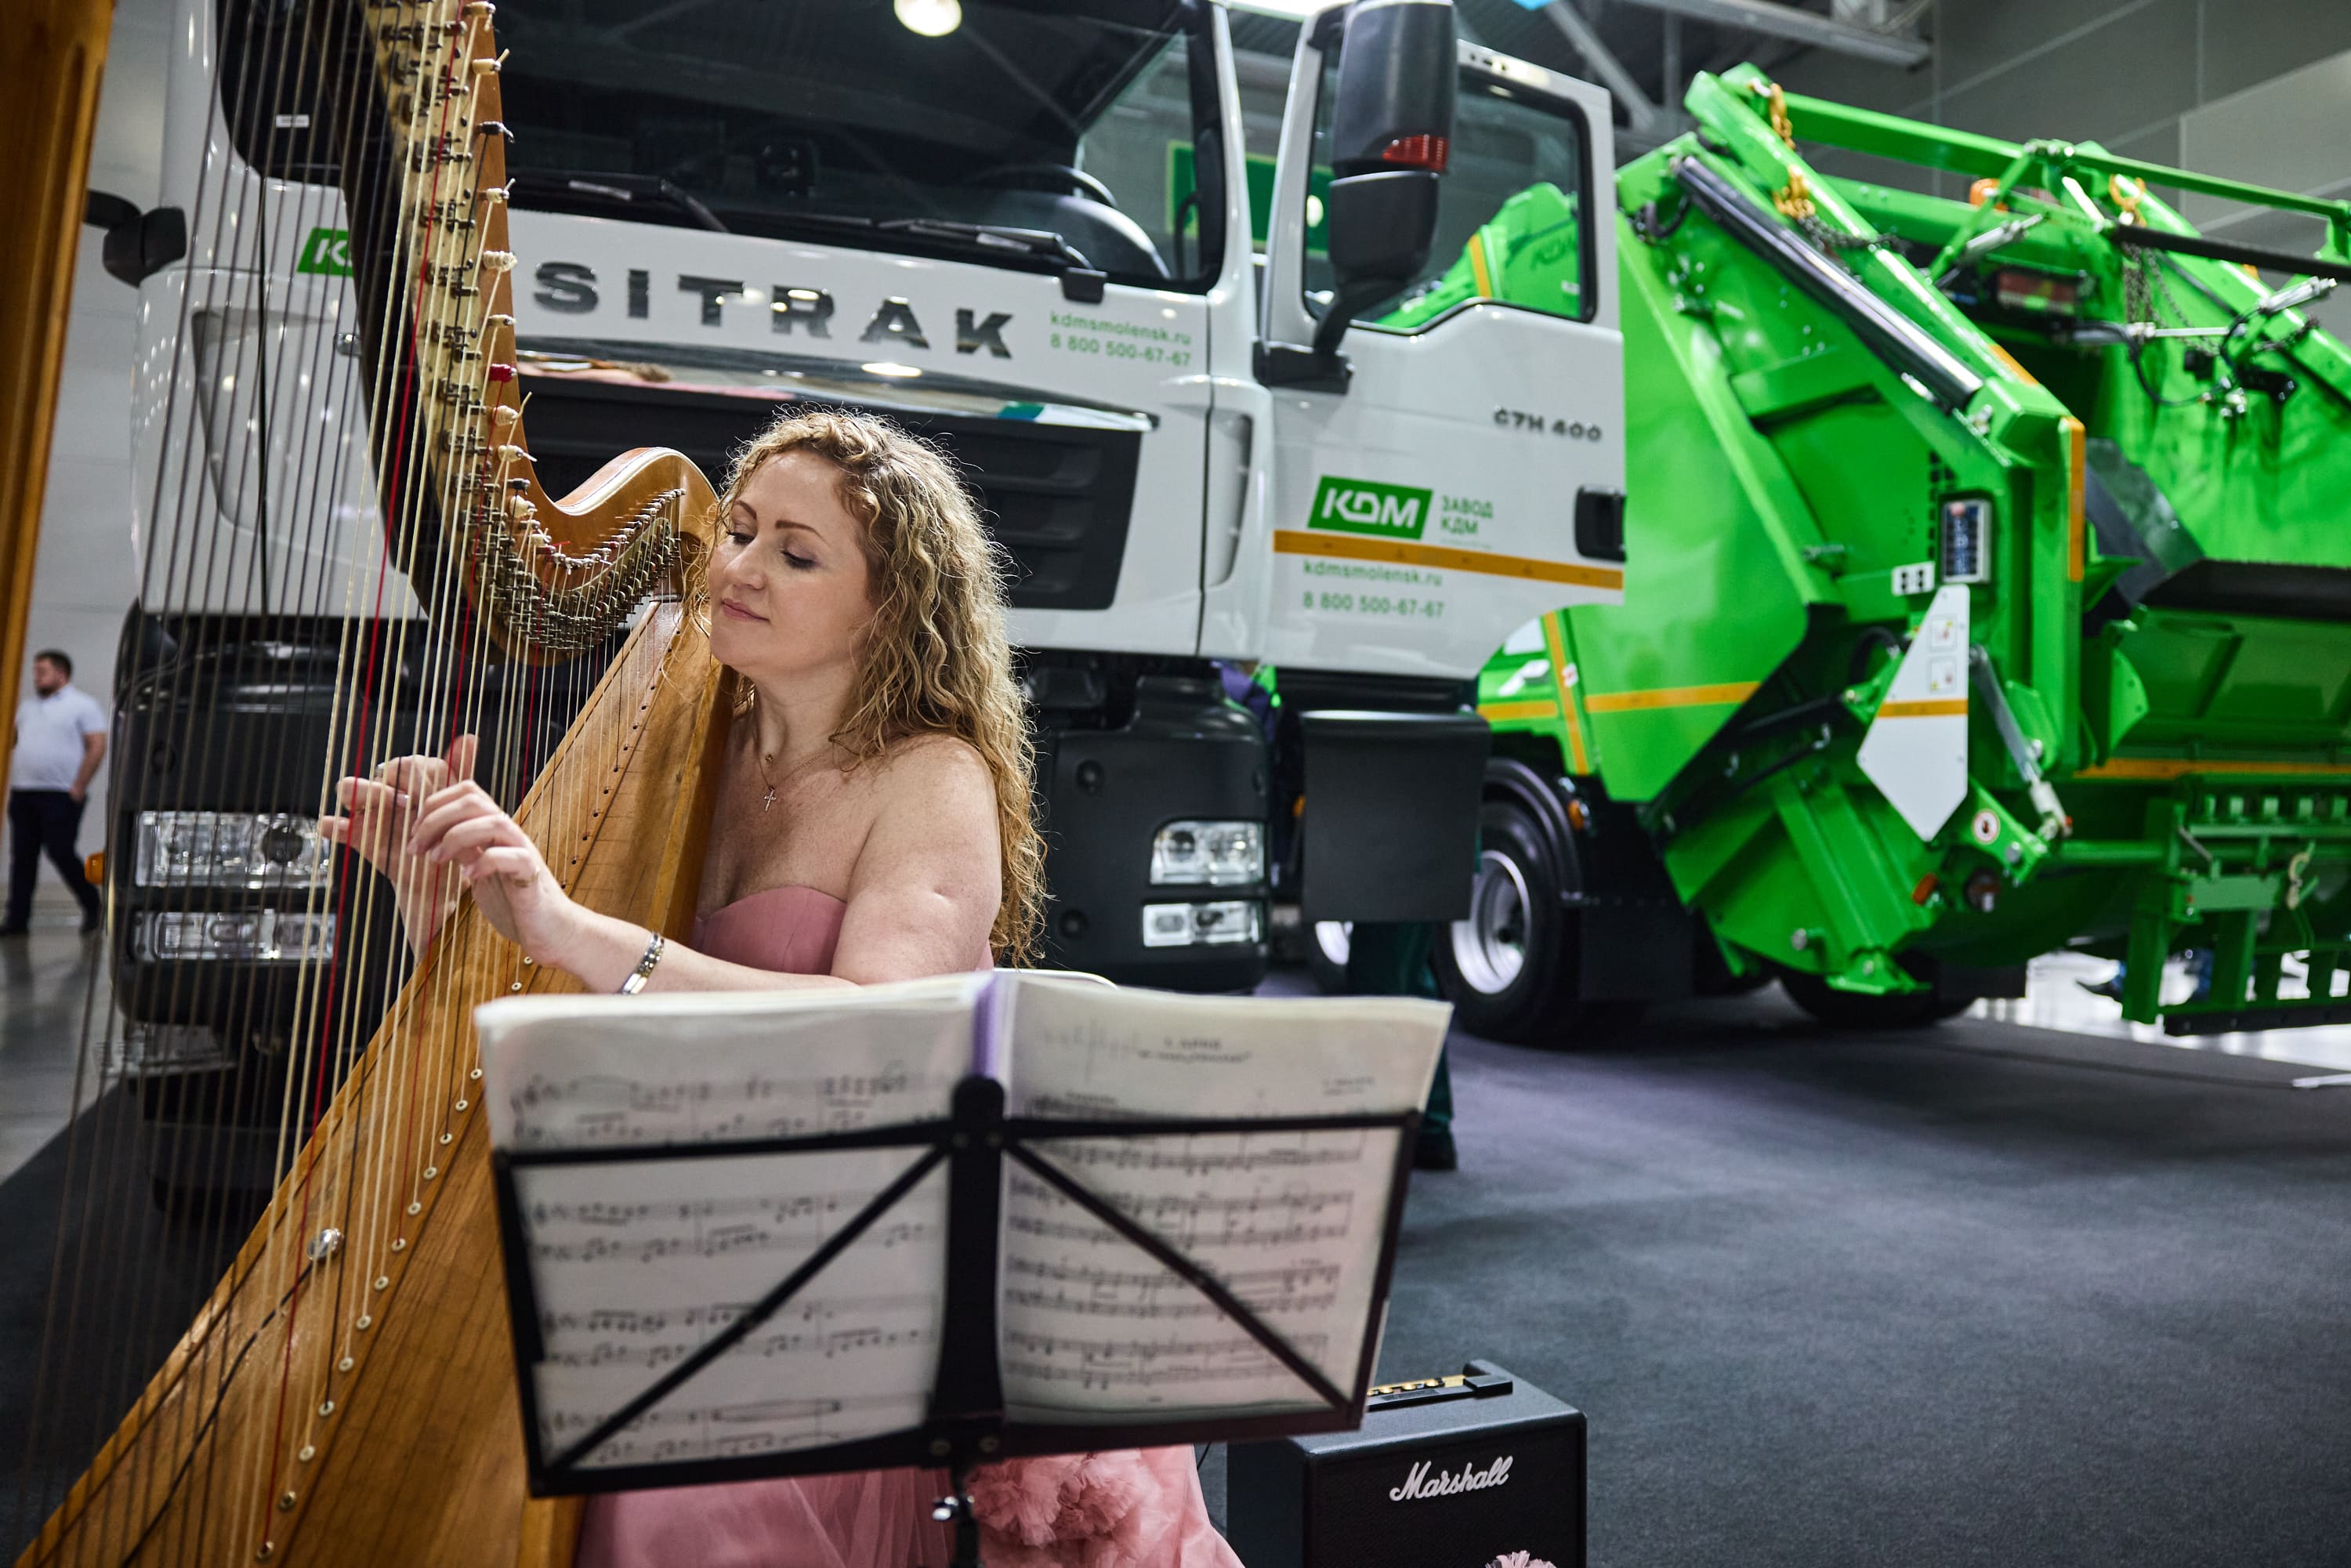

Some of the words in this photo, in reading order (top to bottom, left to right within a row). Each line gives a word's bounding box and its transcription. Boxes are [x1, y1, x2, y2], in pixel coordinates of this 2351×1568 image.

[534, 261, 1013, 359] SITRAK
[1050, 312, 1191, 345] kdmsmolensk.ru
[1051, 332, 1061, 348] 8
[1067, 335, 1099, 353] 800
[1106, 340, 1191, 366] 500-67-67
[1552, 419, 1603, 442] 400
[1441, 495, 1492, 518] ЗАВОД
[1440, 517, 1477, 534] КДМ
[1303, 559, 1443, 586] kdmsmolensk.ru
[1303, 591, 1313, 609] 8
[1320, 592, 1353, 610] 800
[1360, 596, 1444, 617] 500-67-67
[1389, 1455, 1513, 1501] Marshall
